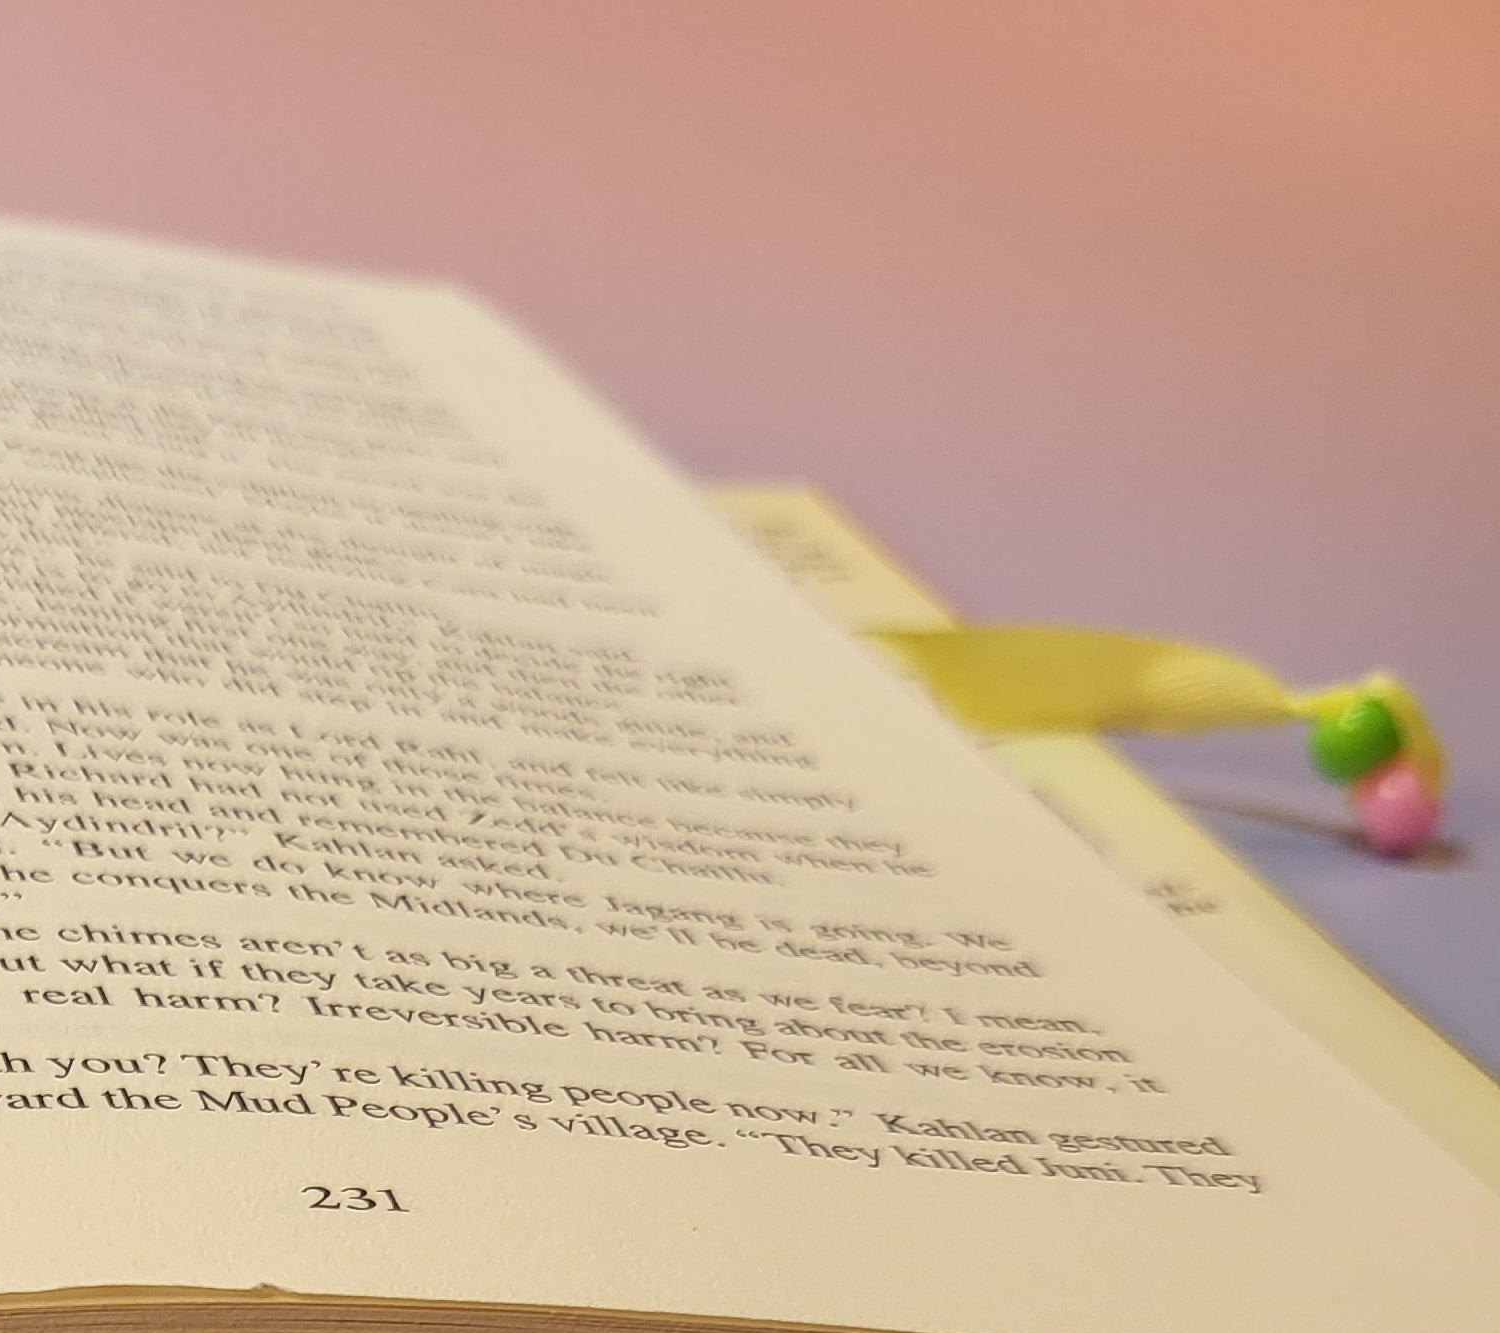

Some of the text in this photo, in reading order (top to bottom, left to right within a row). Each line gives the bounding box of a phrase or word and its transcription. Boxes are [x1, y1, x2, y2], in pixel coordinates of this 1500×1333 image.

[70, 872, 273, 898] conquers
[286, 883, 355, 905] the
[56, 923, 223, 949] chimes
[384, 949, 432, 967] as
[439, 950, 519, 979] big
[529, 965, 557, 980] a
[565, 965, 690, 996] threat
[701, 985, 748, 1003] as
[757, 993, 821, 1011] we
[940, 1006, 967, 1026] I
[59, 954, 173, 976] what
[188, 958, 224, 979] if
[239, 962, 337, 991] they
[353, 972, 451, 997] take
[461, 986, 582, 1010] years
[590, 997, 637, 1016] to
[642, 1000, 767, 1036] bring
[773, 1018, 895, 1046] about
[898, 1030, 969, 1053] the
[976, 1041, 1134, 1063] erosion
[21, 985, 112, 1006] real
[132, 986, 281, 1013] harm?
[305, 995, 571, 1038] Irreversible
[581, 1021, 723, 1055] harm?
[738, 1040, 815, 1066] For
[833, 1052, 892, 1074] all
[903, 1062, 971, 1081] we
[976, 1064, 1120, 1094] know,
[1122, 1073, 1169, 1094] it
[46, 1053, 168, 1079] you?
[388, 1064, 554, 1104] killing
[559, 1085, 718, 1114] people
[874, 1113, 1040, 1145] Kahlan
[1046, 1132, 1234, 1157] gestured
[101, 1087, 183, 1110] the
[194, 1089, 316, 1115] Mud
[548, 1113, 728, 1149] village.
[890, 1145, 1031, 1175] killed
[1033, 1156, 1146, 1184] Juni.
[1140, 1164, 1264, 1195] They
[301, 1184, 411, 1214] 231
